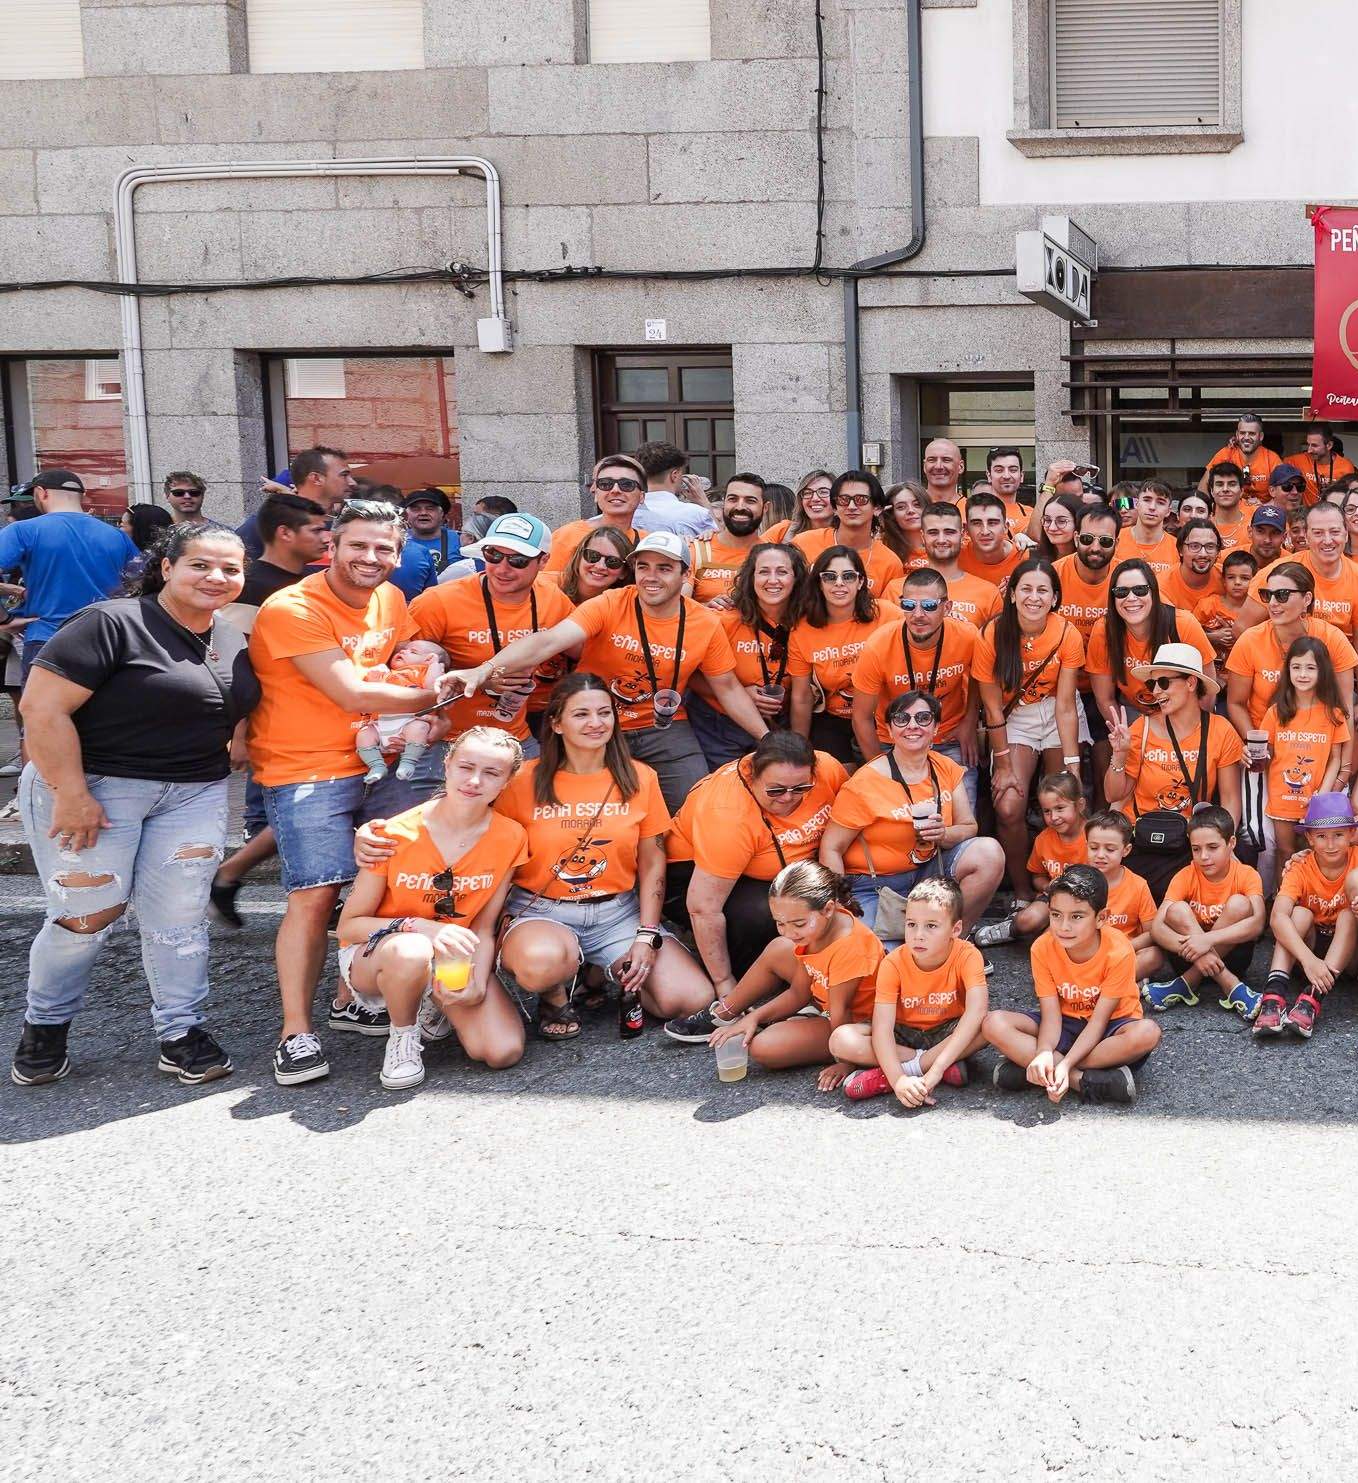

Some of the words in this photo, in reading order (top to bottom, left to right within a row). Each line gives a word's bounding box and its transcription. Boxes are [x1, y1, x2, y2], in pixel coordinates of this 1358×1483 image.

[648, 328, 662, 339] 24
[951, 601, 976, 614] PETO
[1057, 604, 1083, 617] PEÑA
[1085, 606, 1109, 618] ESP
[813, 646, 839, 663] PEÑA
[841, 640, 866, 657] ESP
[894, 672, 924, 686] PEA
[1262, 669, 1281, 683] PEÑ
[1277, 730, 1296, 742] PEÑA
[1298, 732, 1328, 744] ESPETO
[533, 802, 571, 820] PEÑA
[576, 801, 630, 817] ESPETO
[891, 804, 912, 819] PEÑ
[452, 874, 494, 891] SPETO
[1108, 913, 1128, 925] PETO
[928, 990, 958, 1006] ESPET
